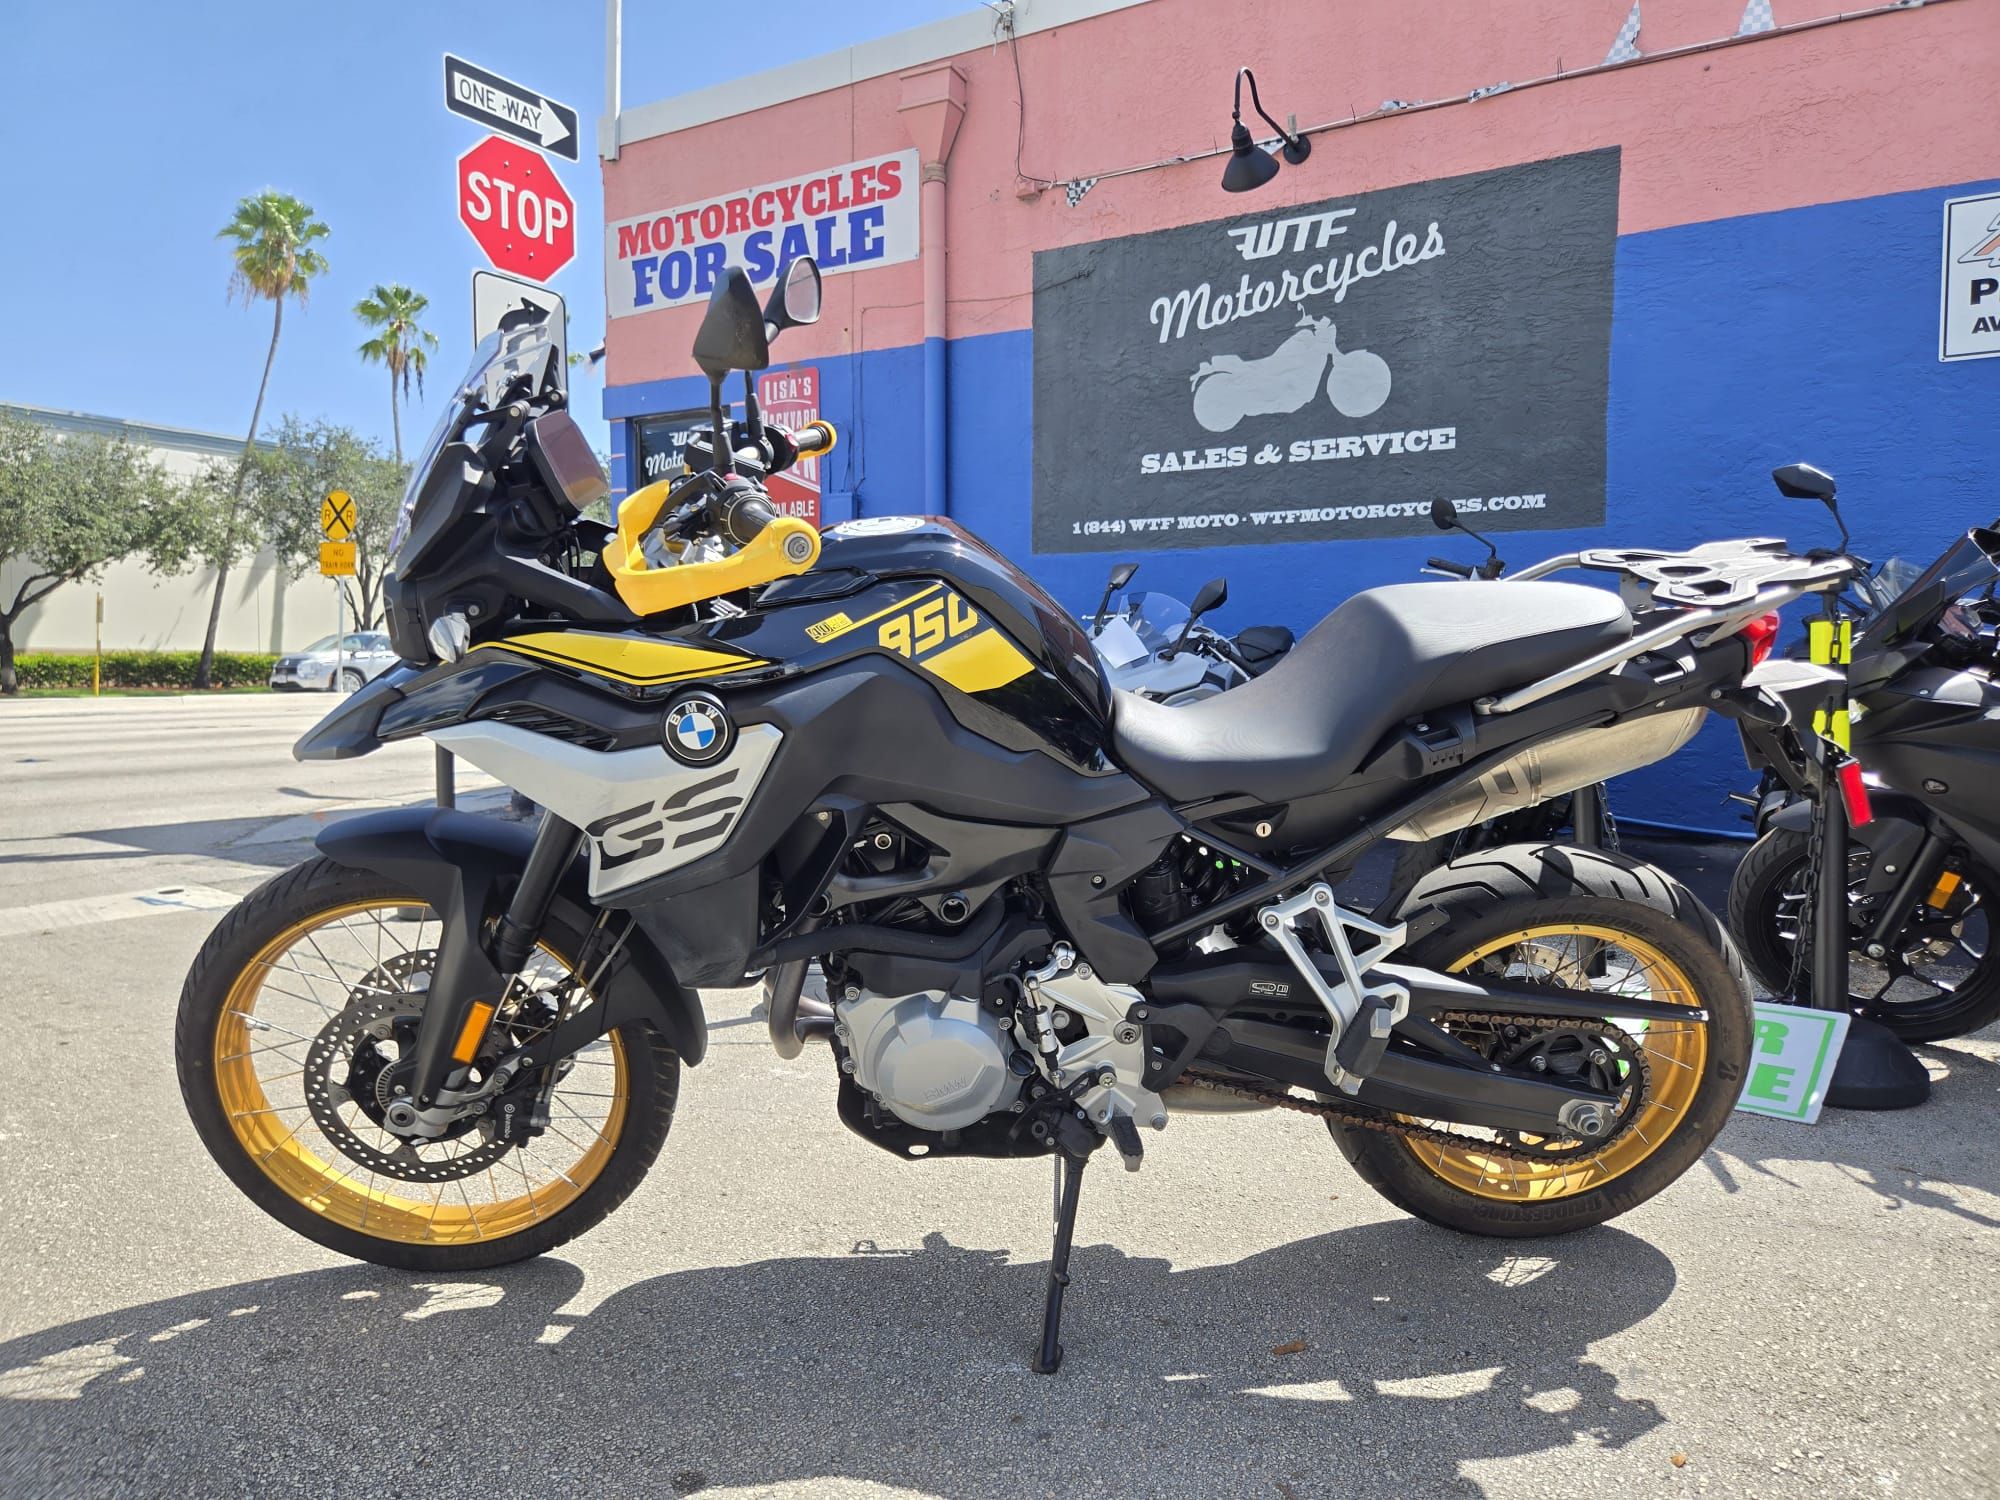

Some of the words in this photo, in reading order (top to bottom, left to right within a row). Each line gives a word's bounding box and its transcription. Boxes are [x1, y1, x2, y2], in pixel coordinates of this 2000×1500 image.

[459, 78, 497, 112] ONE
[505, 97, 542, 130] WAY
[466, 171, 568, 246] STOP
[617, 160, 902, 260] MOTORCYCLES
[1227, 208, 1357, 261] WTF
[631, 241, 728, 308] FOR
[743, 205, 885, 285] SALE
[1149, 219, 1446, 344] Motorcycles
[1141, 445, 1248, 475] SALES
[1253, 443, 1284, 465] &
[1288, 426, 1457, 463] SERVICE
[1072, 521, 1082, 535] 1
[1083, 519, 1127, 536] (844)
[1129, 516, 1175, 532] WTF
[1177, 513, 1240, 530] MOTO
[1250, 493, 1547, 526] WTFMOTORCYCES.COM
[669, 702, 718, 726] BMW
[584, 767, 745, 871] GS
